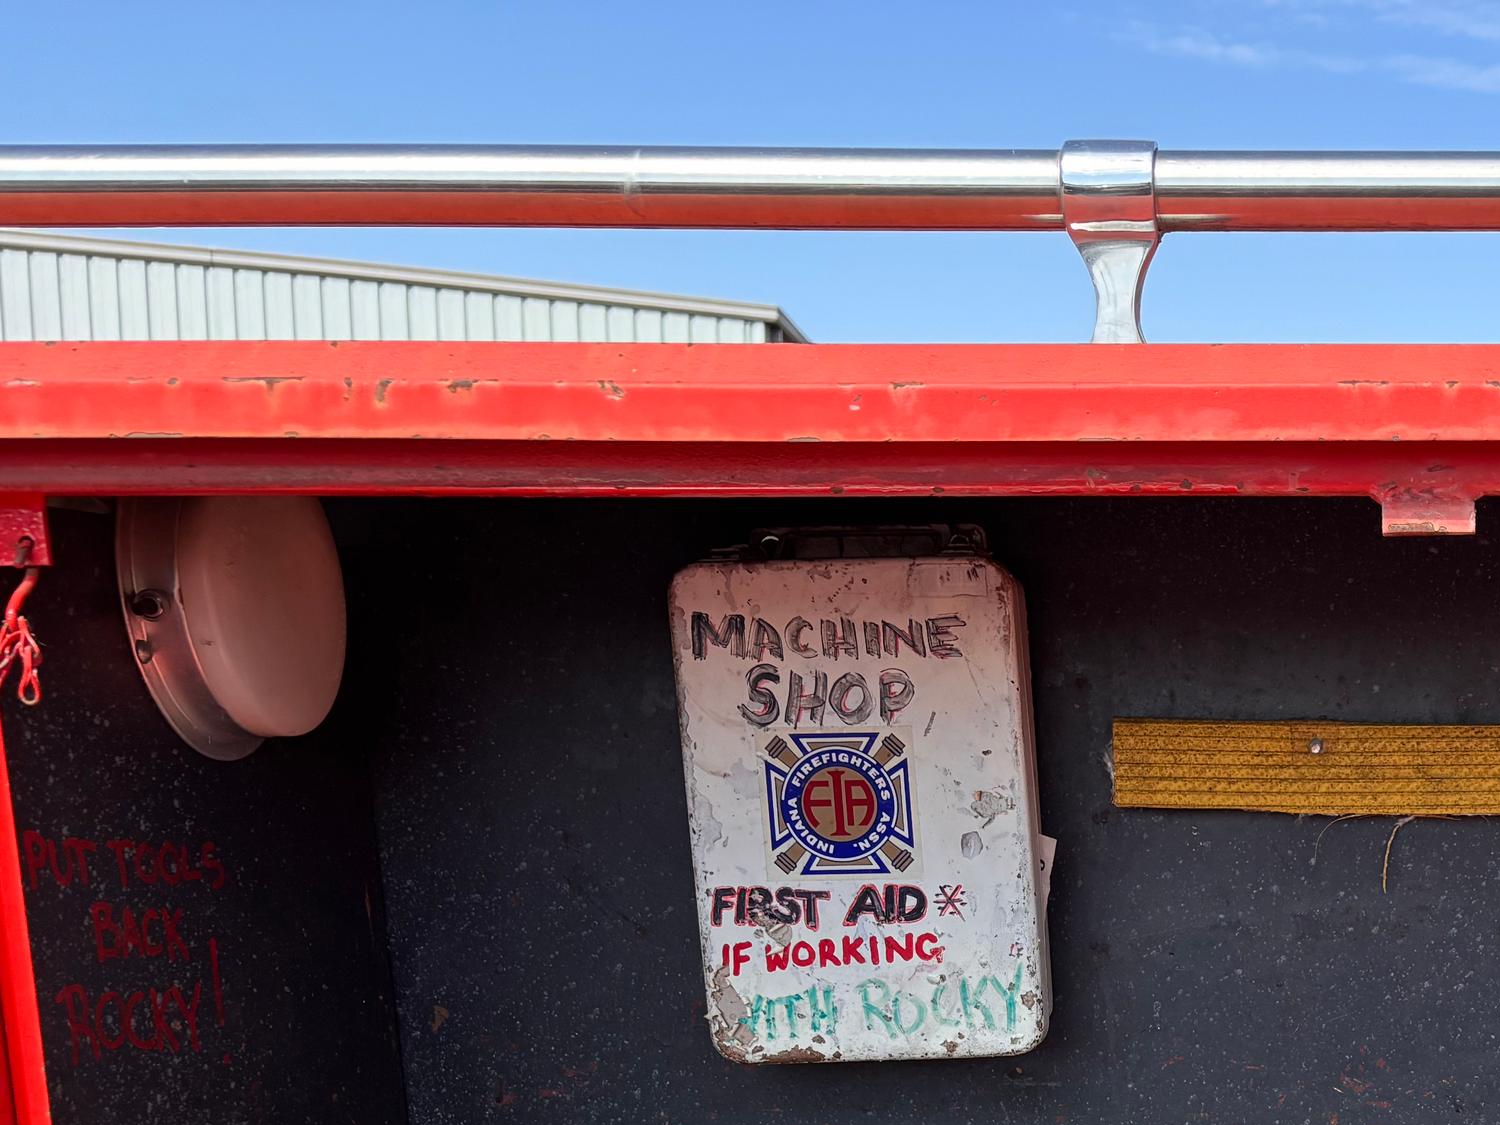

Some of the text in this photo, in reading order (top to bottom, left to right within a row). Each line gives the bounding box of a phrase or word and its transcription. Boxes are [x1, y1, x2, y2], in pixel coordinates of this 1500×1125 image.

[691, 611, 967, 661] MACHINE
[737, 663, 915, 729] SHOP
[787, 752, 892, 855] INDIANA FIREFIGHTERS ASSN.
[23, 830, 227, 890] PUT TOOLS
[92, 901, 190, 963] BACK
[710, 885, 832, 931] FIRST
[721, 932, 945, 976] IF WORKING
[856, 962, 1022, 1040] ROCKY
